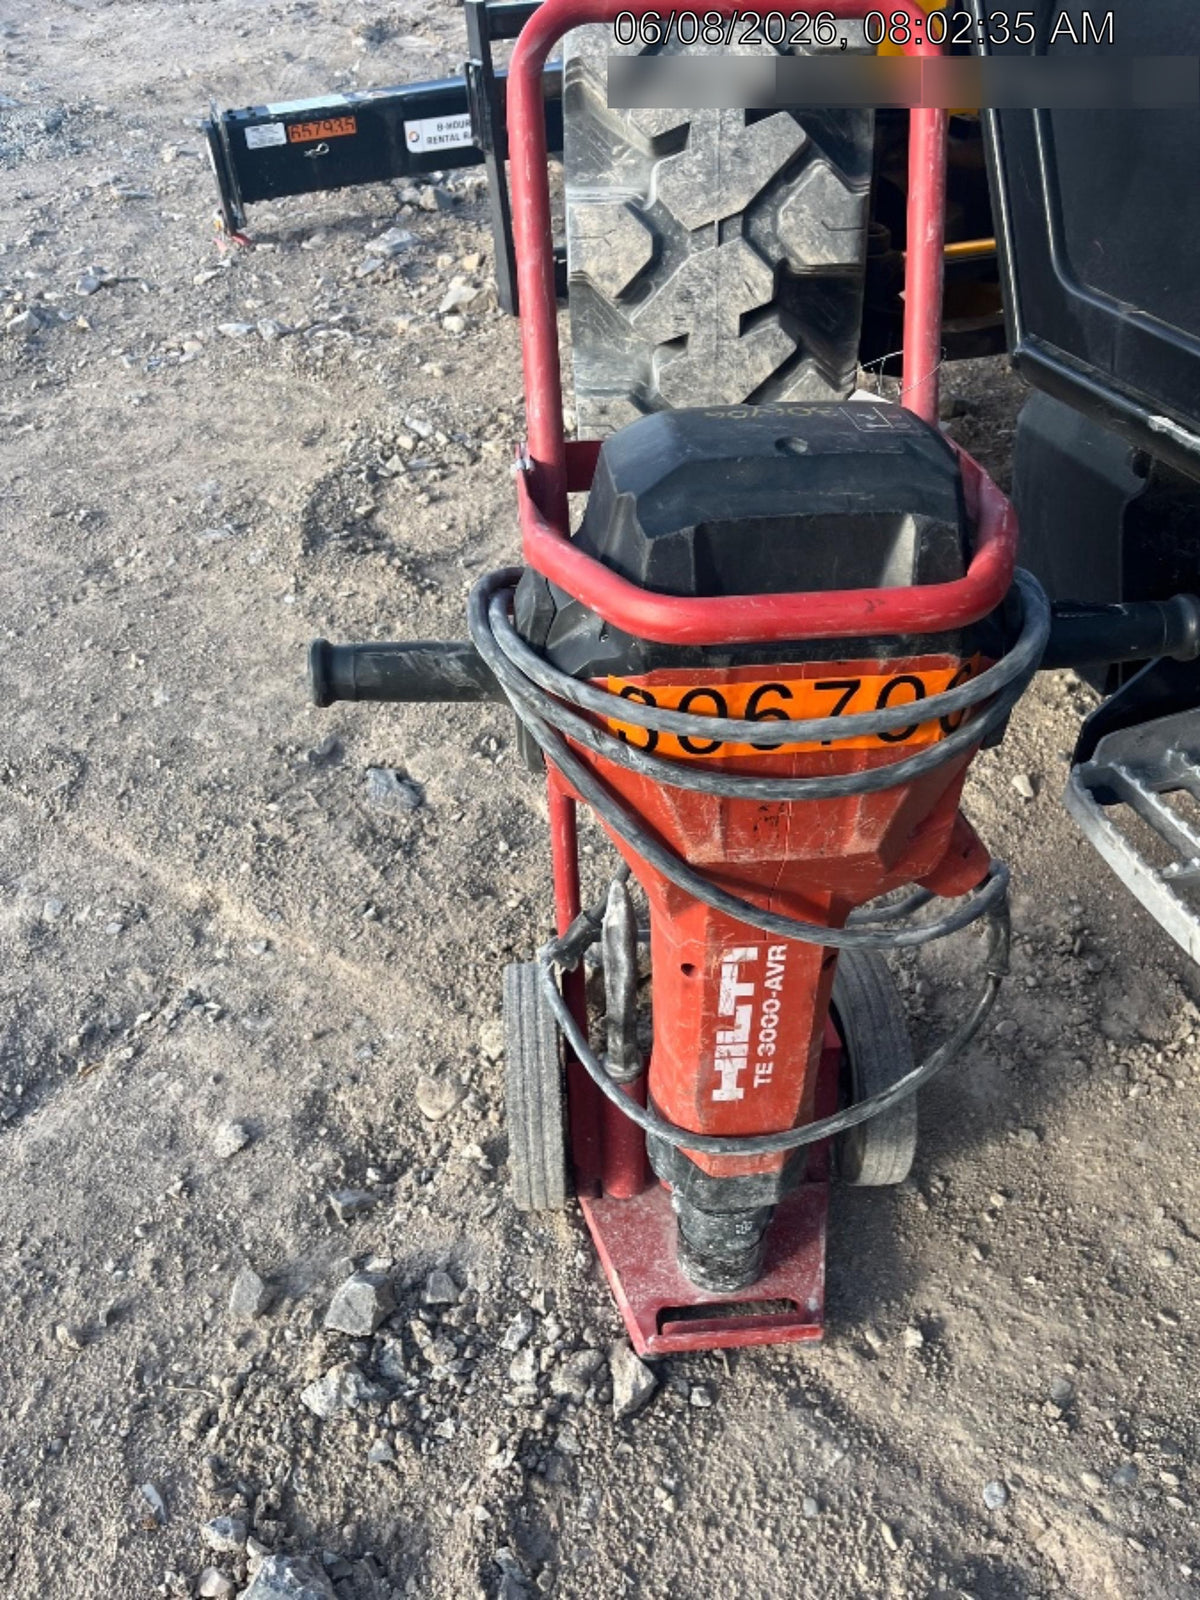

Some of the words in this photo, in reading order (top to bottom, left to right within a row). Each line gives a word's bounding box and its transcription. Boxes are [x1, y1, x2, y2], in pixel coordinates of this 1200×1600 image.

[290, 117, 355, 139] 657935
[426, 133, 460, 145] RENTAL
[756, 943, 788, 1057] 3000-AVR
[711, 946, 759, 1102] HILTI
[753, 1061, 774, 1089] TE
